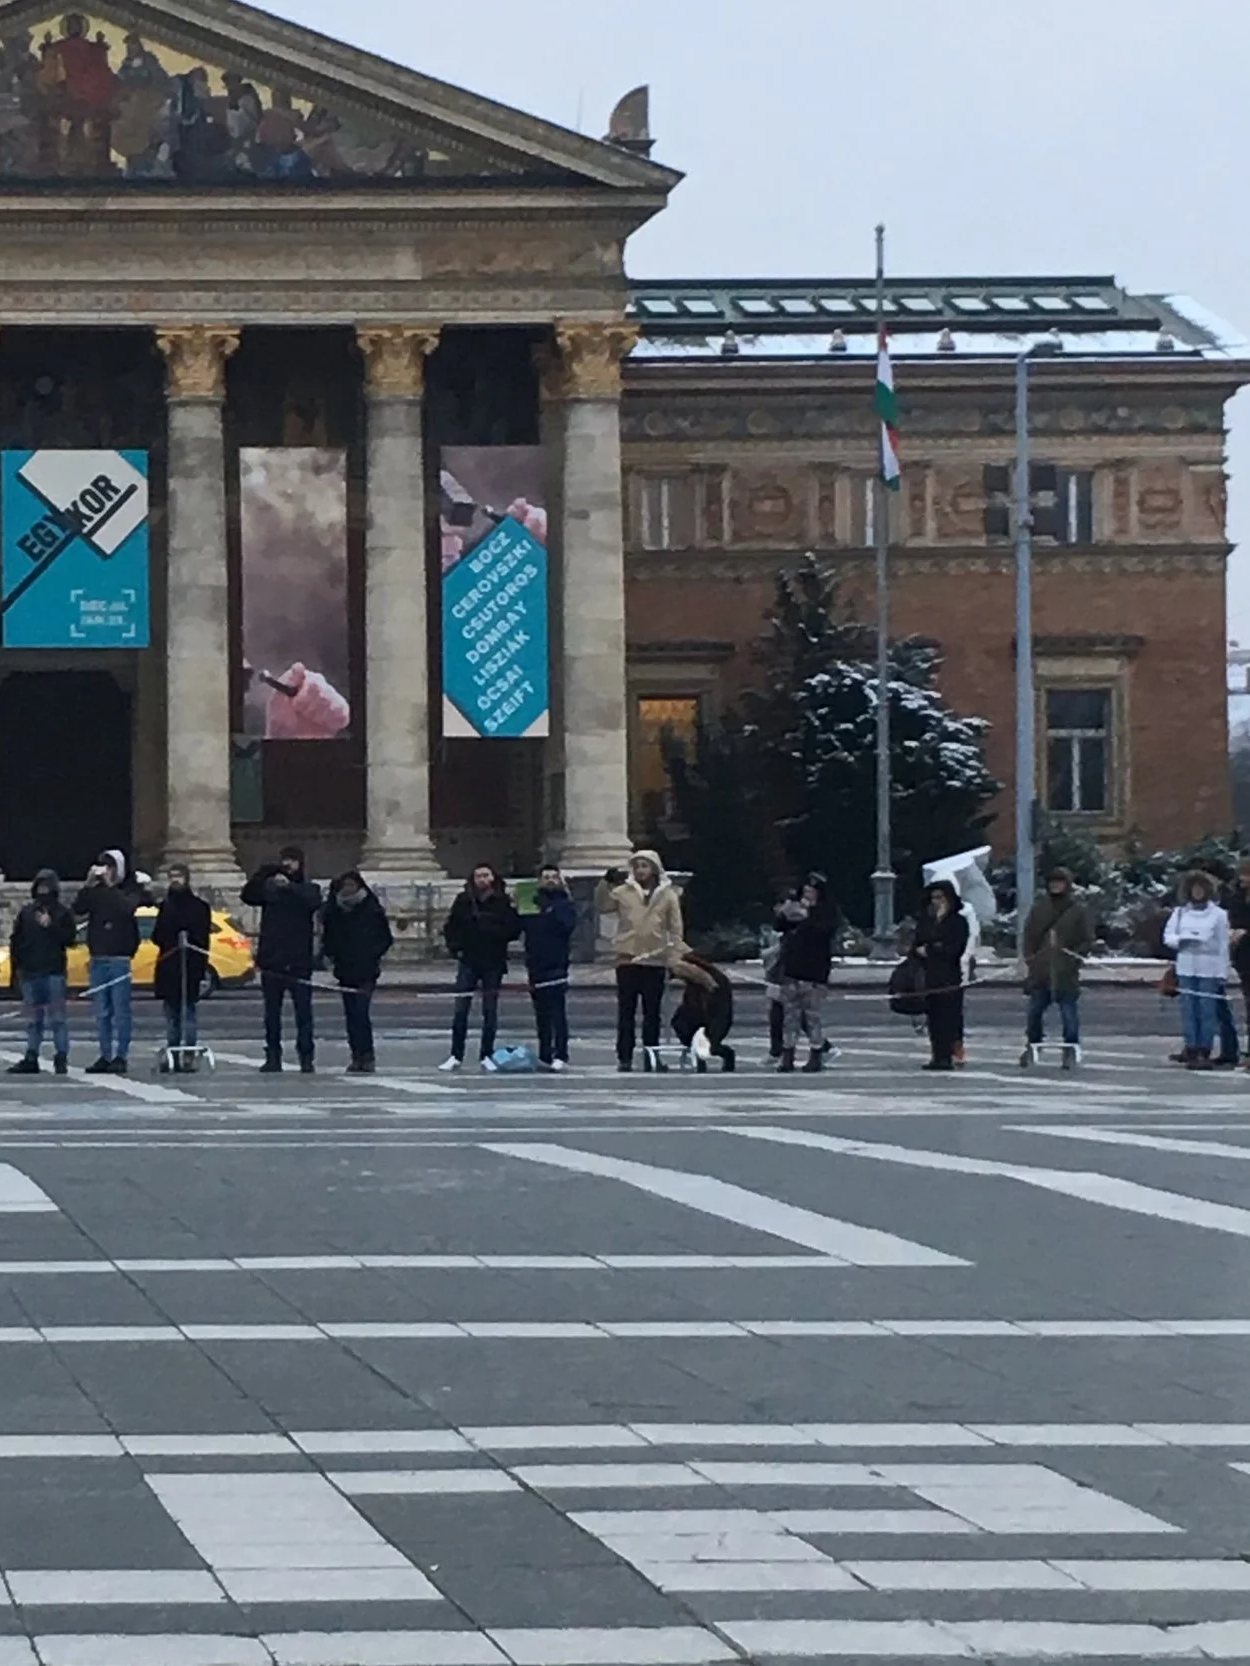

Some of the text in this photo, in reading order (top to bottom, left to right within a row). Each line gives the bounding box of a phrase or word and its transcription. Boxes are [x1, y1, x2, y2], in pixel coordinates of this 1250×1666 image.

[451, 539, 532, 618] CEROVSZKI
[469, 531, 511, 573] BOCZ
[462, 563, 538, 639] CSUTOROS
[465, 601, 528, 664] DOMBAY
